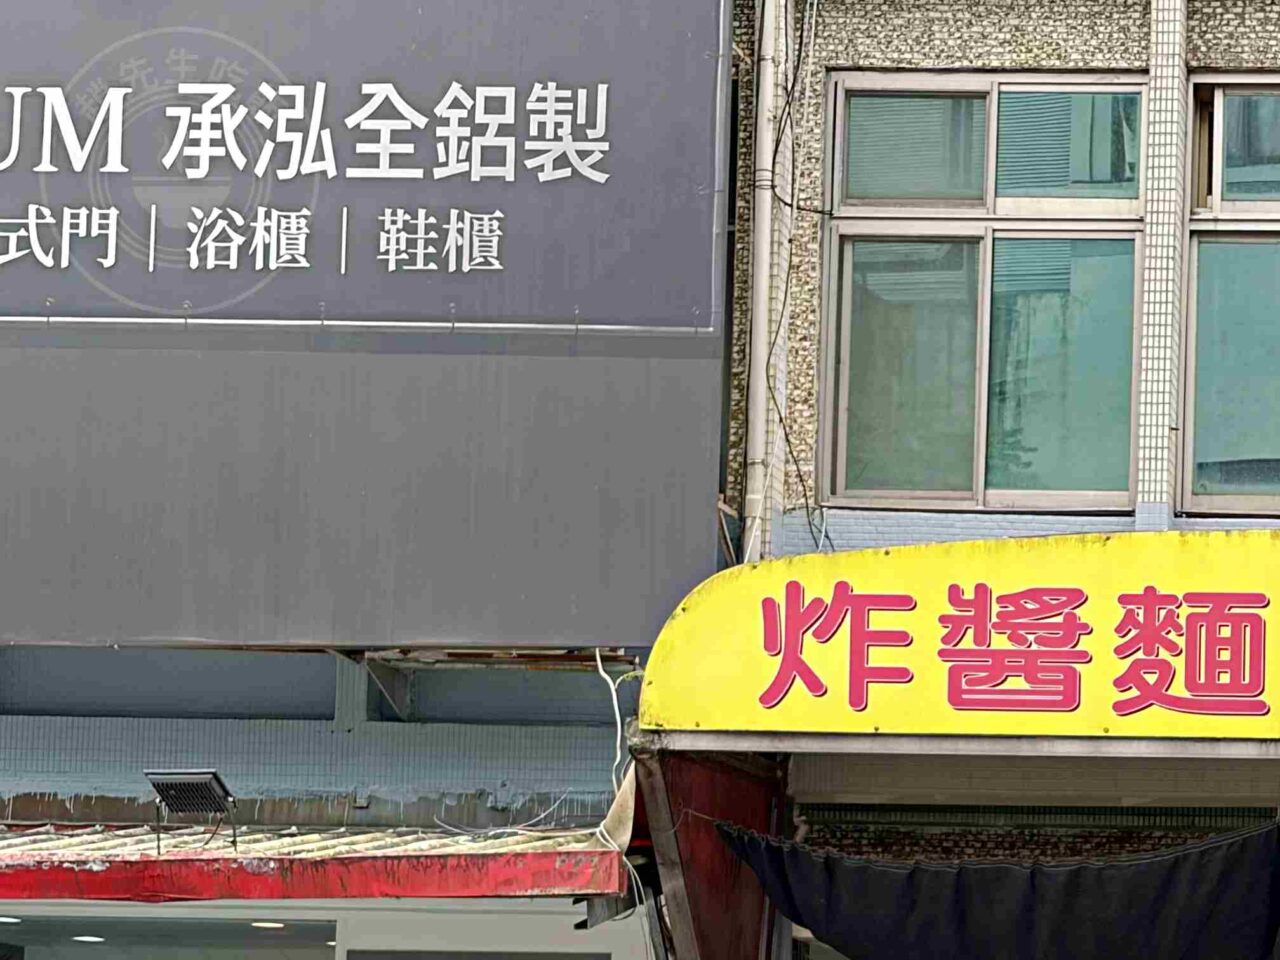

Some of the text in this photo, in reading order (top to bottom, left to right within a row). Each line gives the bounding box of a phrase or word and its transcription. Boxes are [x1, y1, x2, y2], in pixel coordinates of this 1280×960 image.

[162, 82, 611, 185] 承泓全鋁製
[0, 203, 505, 273] 式門 浴櫃 鞋櫃
[758, 580, 1271, 716] 炸醬麵
